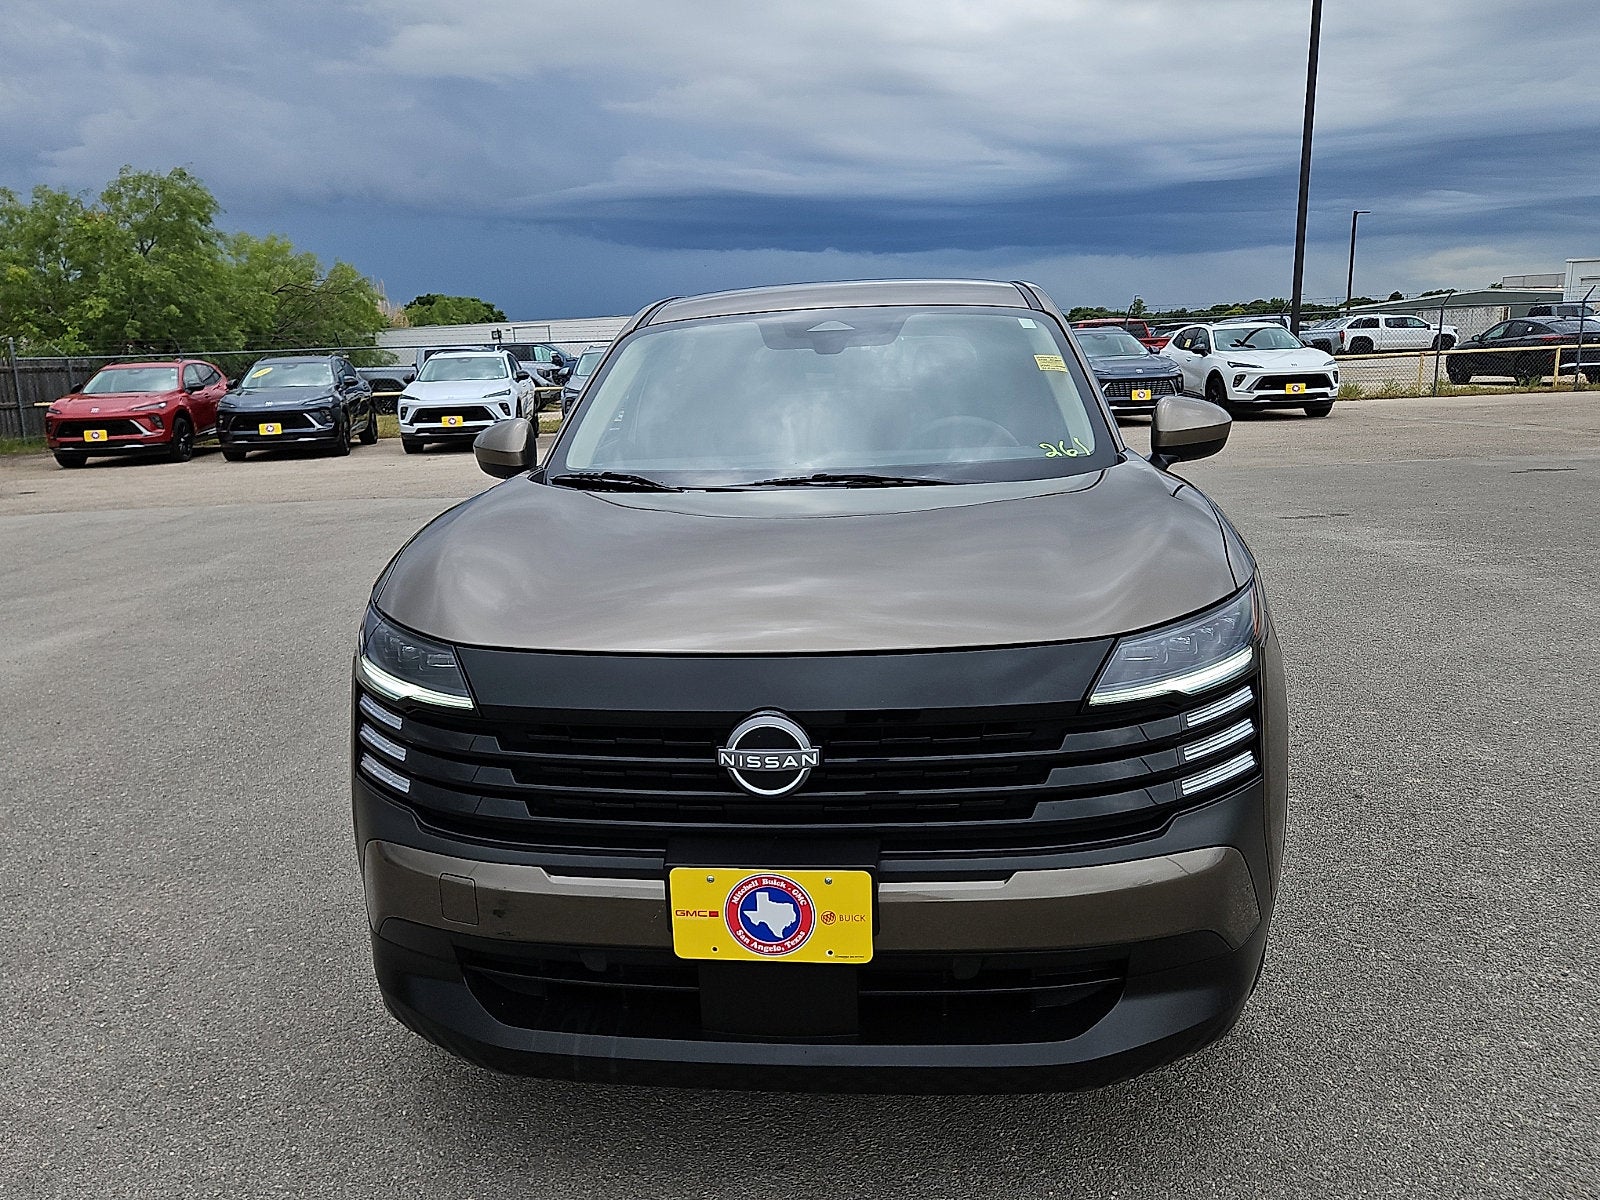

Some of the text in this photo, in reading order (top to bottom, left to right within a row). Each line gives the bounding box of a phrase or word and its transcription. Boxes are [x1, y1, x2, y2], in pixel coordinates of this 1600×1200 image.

[1039, 437, 1091, 457] 261
[720, 752, 817, 768] NISSAN
[731, 879, 759, 904] Mitchell
[761, 878, 787, 888] Buick
[791, 889, 807, 906] GMC
[675, 909, 708, 917] GMC
[839, 914, 866, 922] BUICK
[736, 929, 806, 953] San Angelo, Texas
